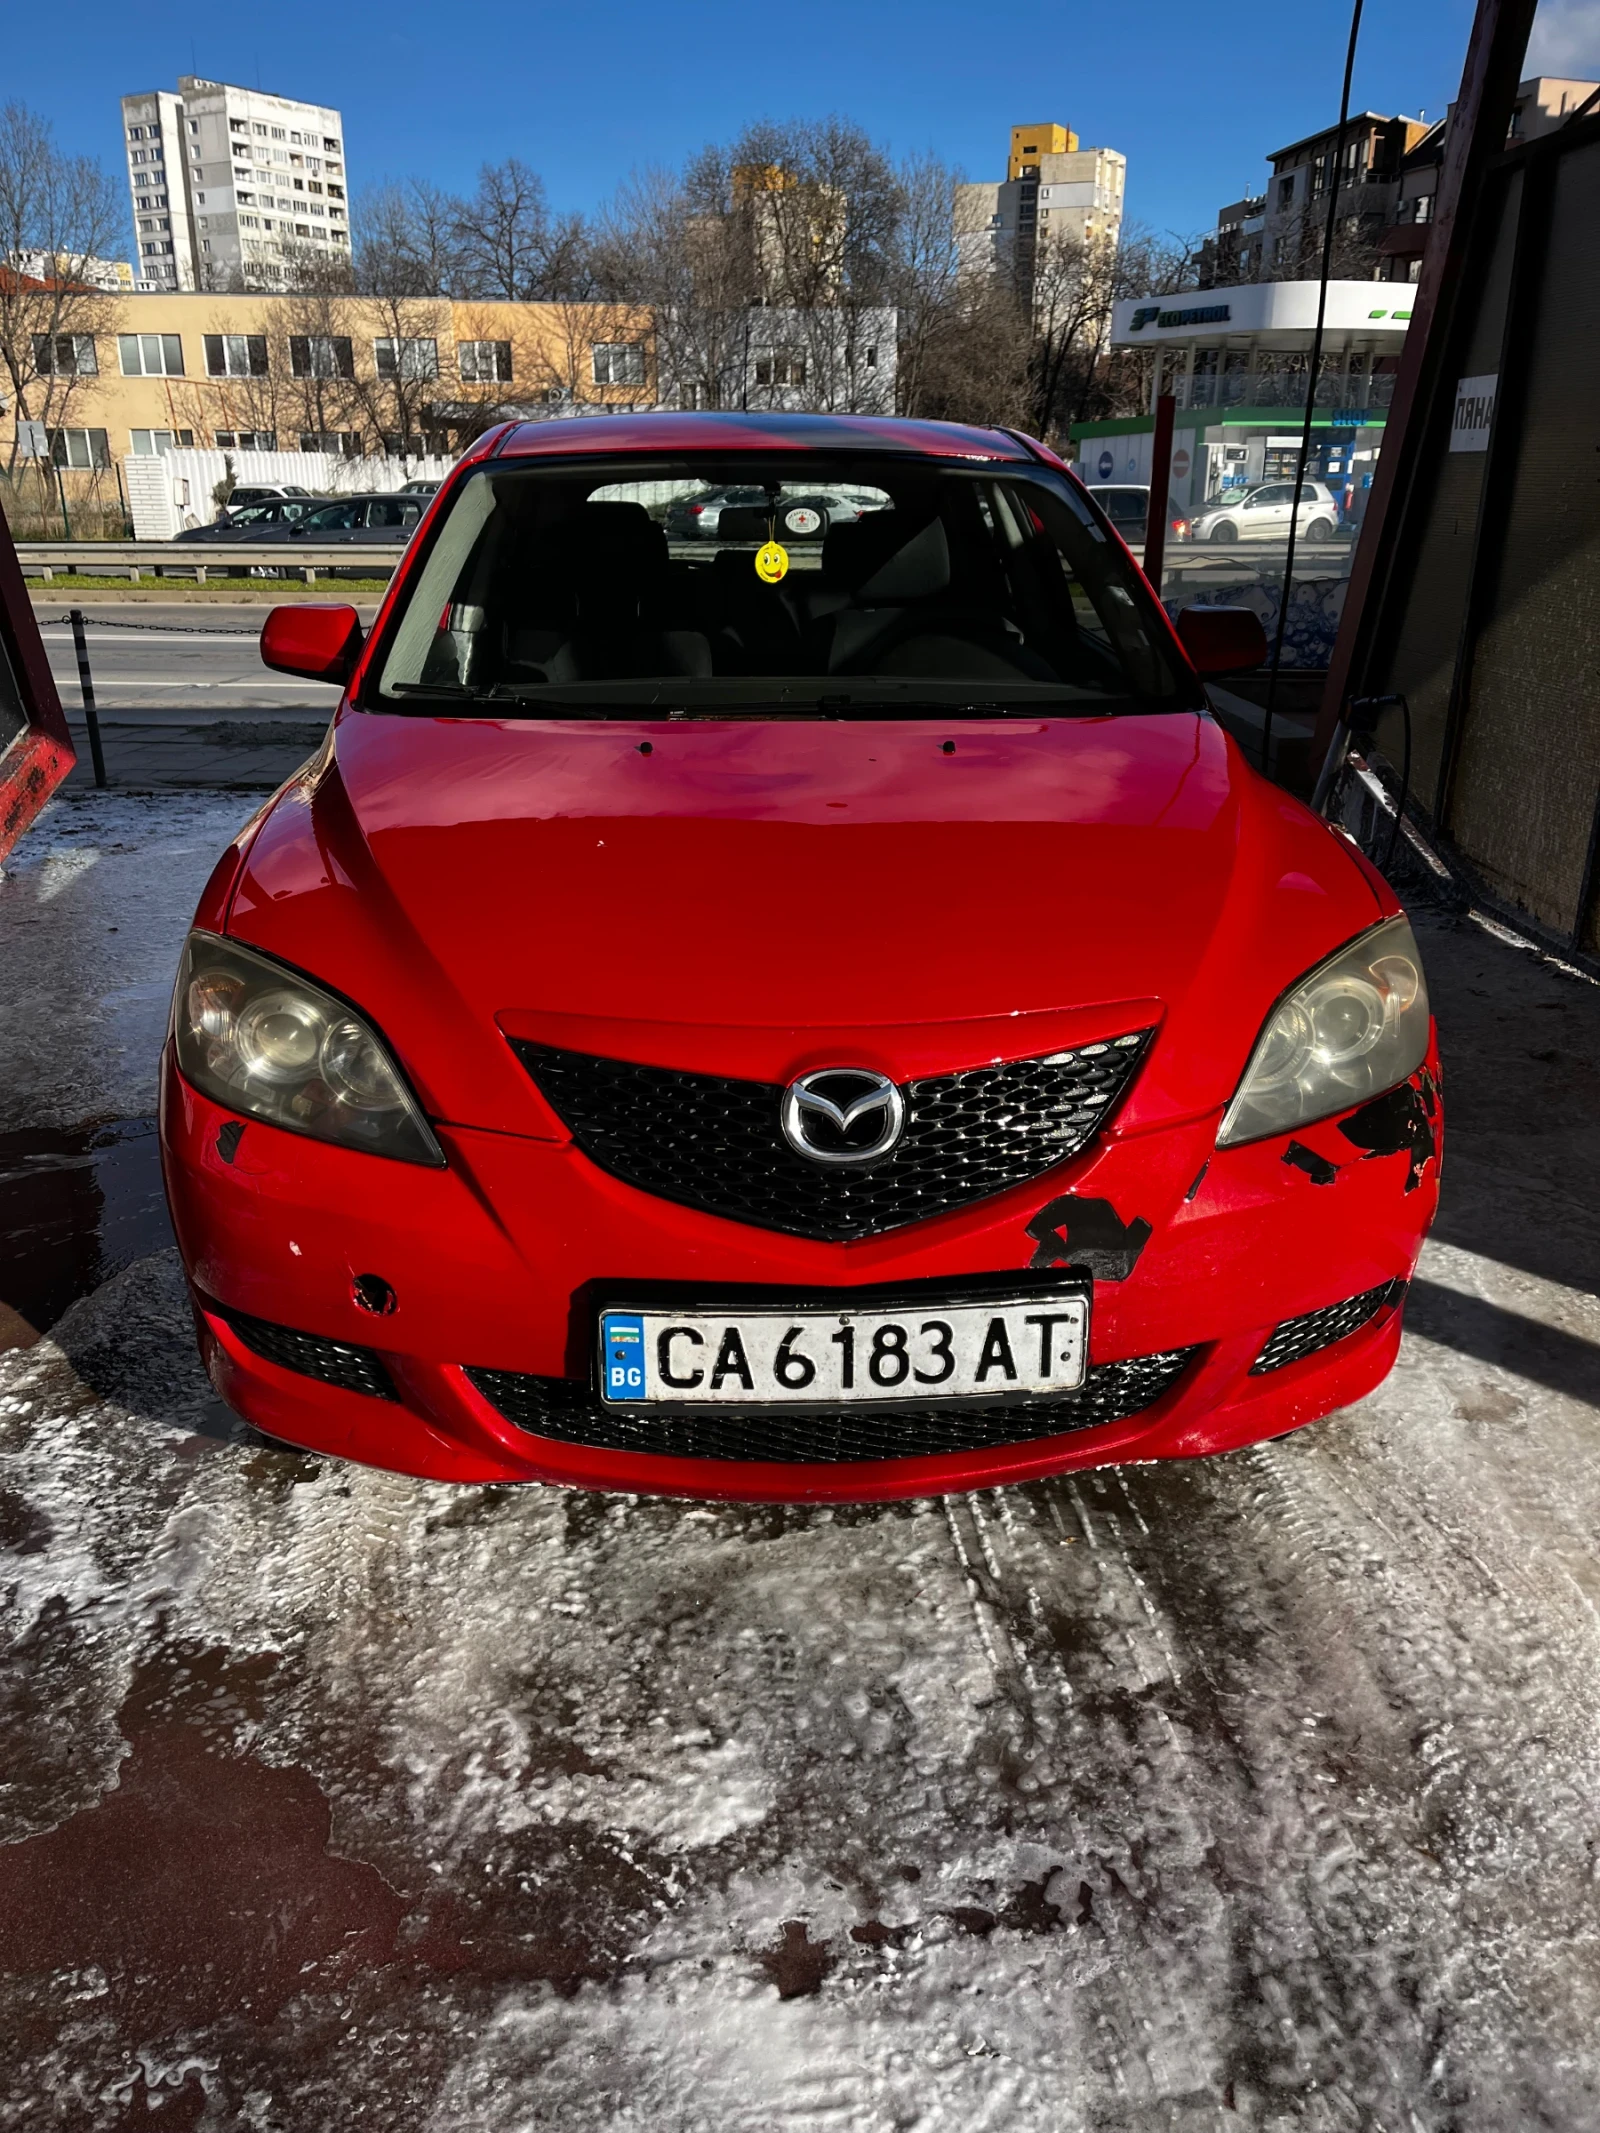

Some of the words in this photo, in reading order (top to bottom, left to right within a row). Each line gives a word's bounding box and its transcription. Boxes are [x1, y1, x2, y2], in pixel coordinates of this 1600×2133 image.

[1157, 304, 1231, 328] ECOPETROL
[1332, 409, 1372, 426] SHOP
[1455, 396, 1493, 429] ПЯНА
[611, 1366, 642, 1387] BG
